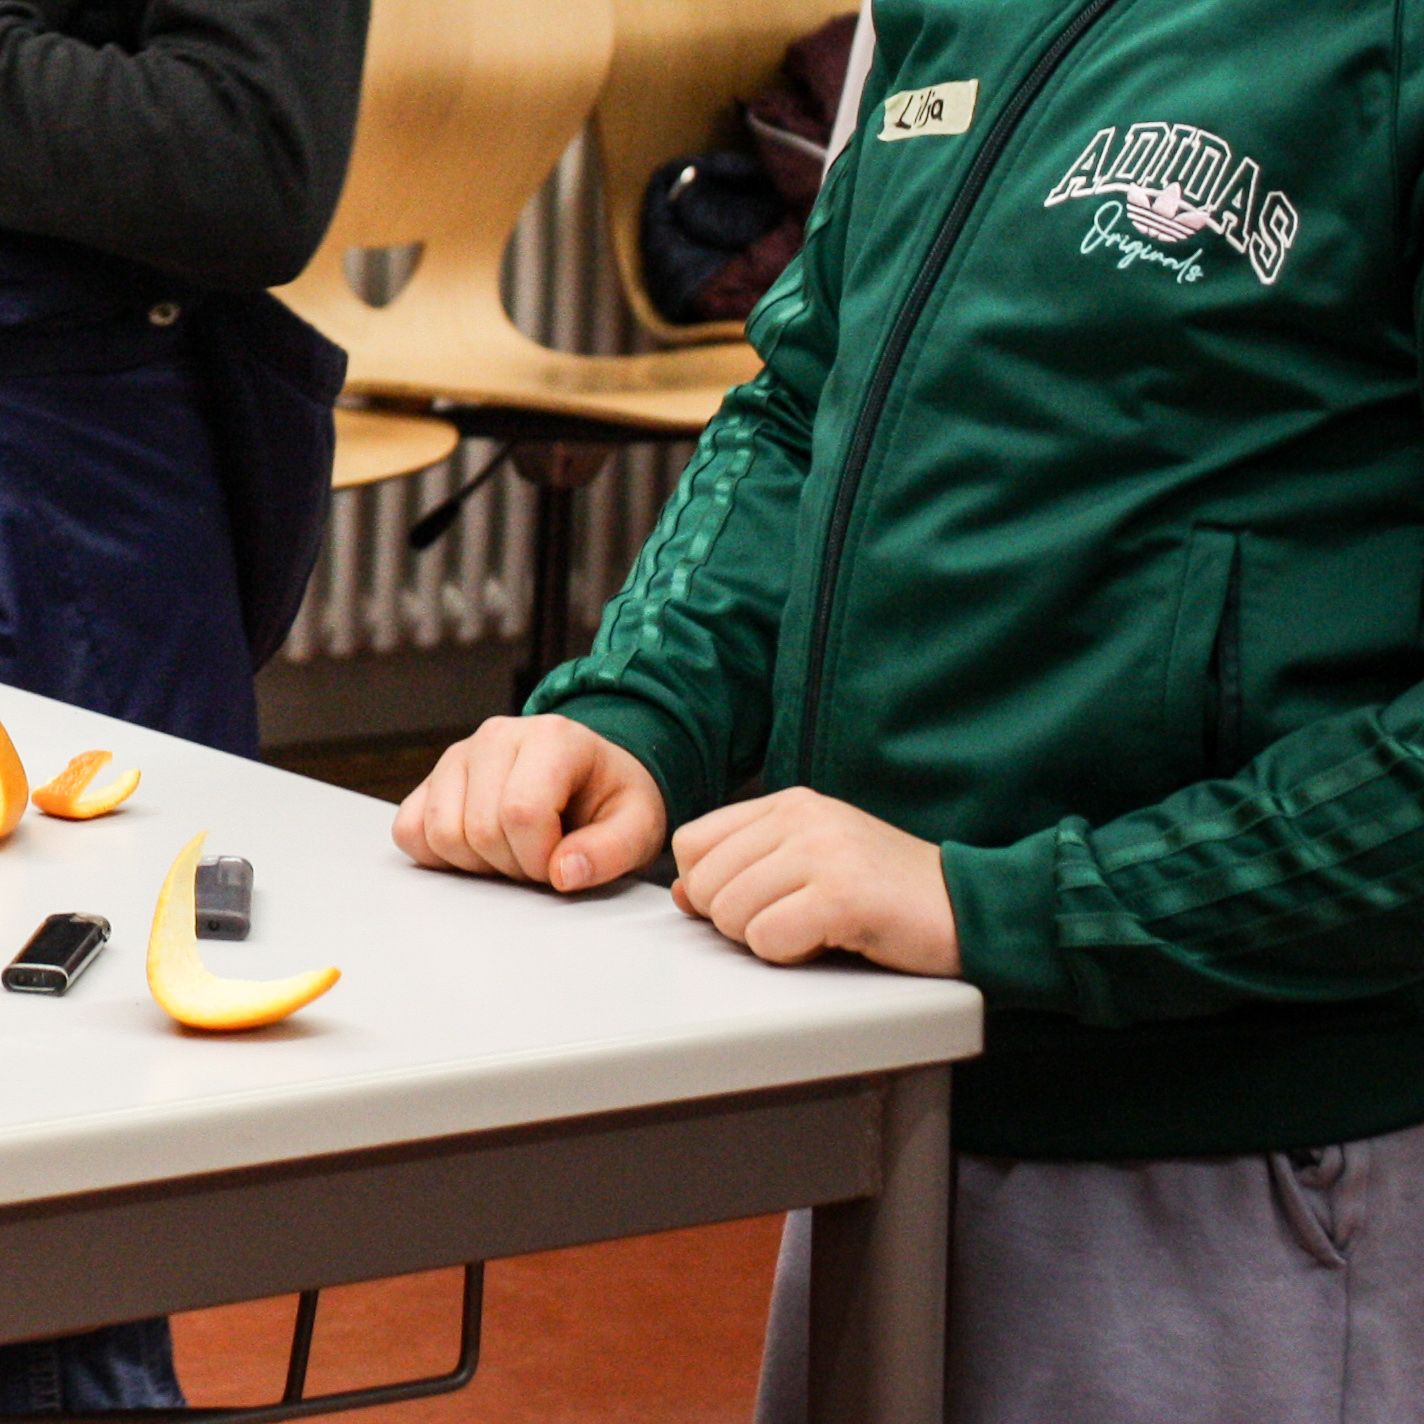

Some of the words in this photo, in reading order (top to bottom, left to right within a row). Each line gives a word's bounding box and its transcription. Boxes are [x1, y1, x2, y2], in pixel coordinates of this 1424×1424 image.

[895, 89, 944, 129] Lilja
[1045, 122, 1298, 284] ADIDAS
[1080, 200, 1204, 284] Originals
